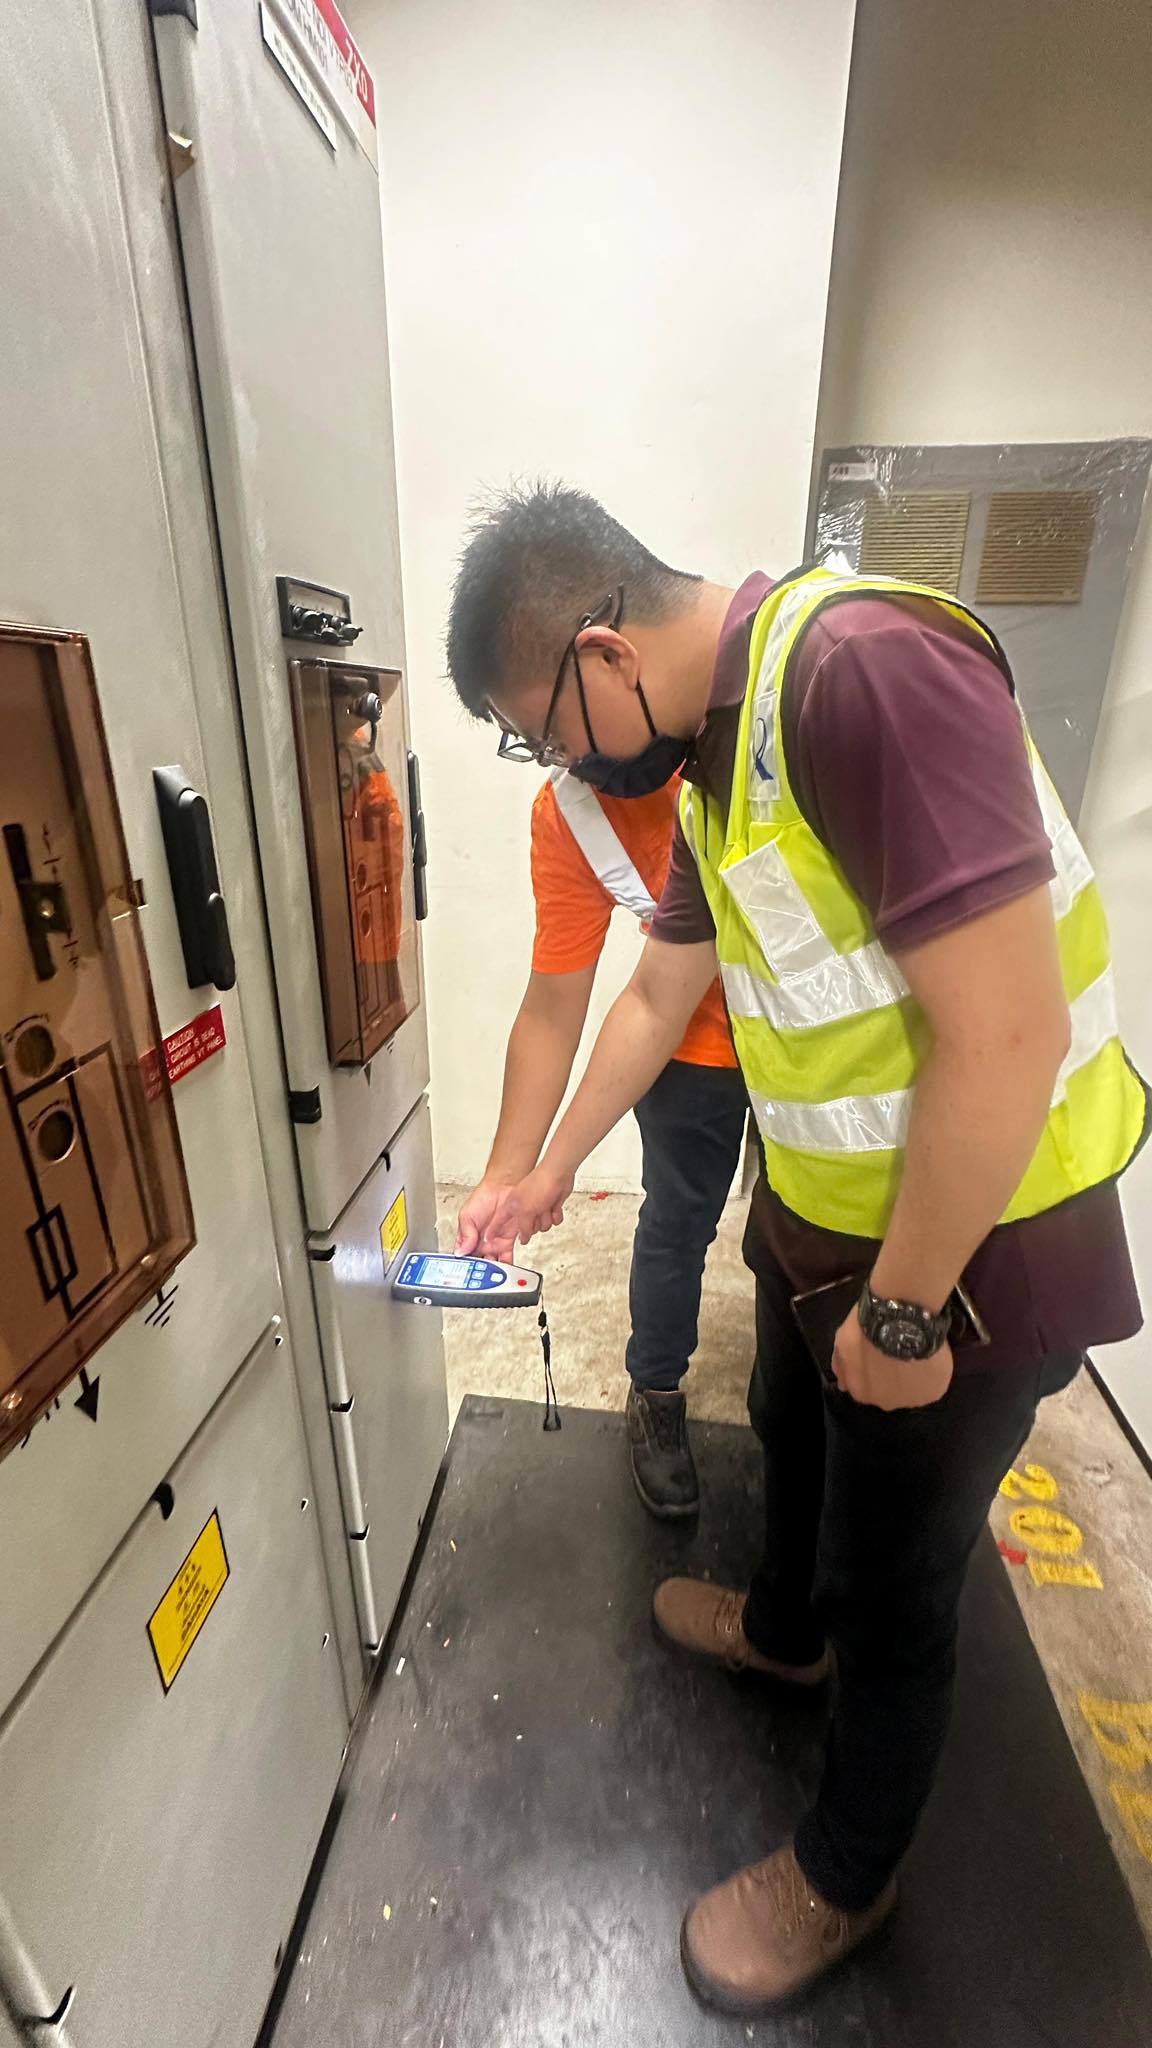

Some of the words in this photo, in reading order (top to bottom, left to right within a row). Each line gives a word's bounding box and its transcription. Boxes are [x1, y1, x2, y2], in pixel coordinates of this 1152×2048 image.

[167, 1027, 194, 1053] CAUTION
[168, 1053, 196, 1079] EARTHING
[206, 1035, 223, 1051] PANEL
[171, 1042, 191, 1063] CIRCUIT
[201, 1026, 215, 1042] DEAD
